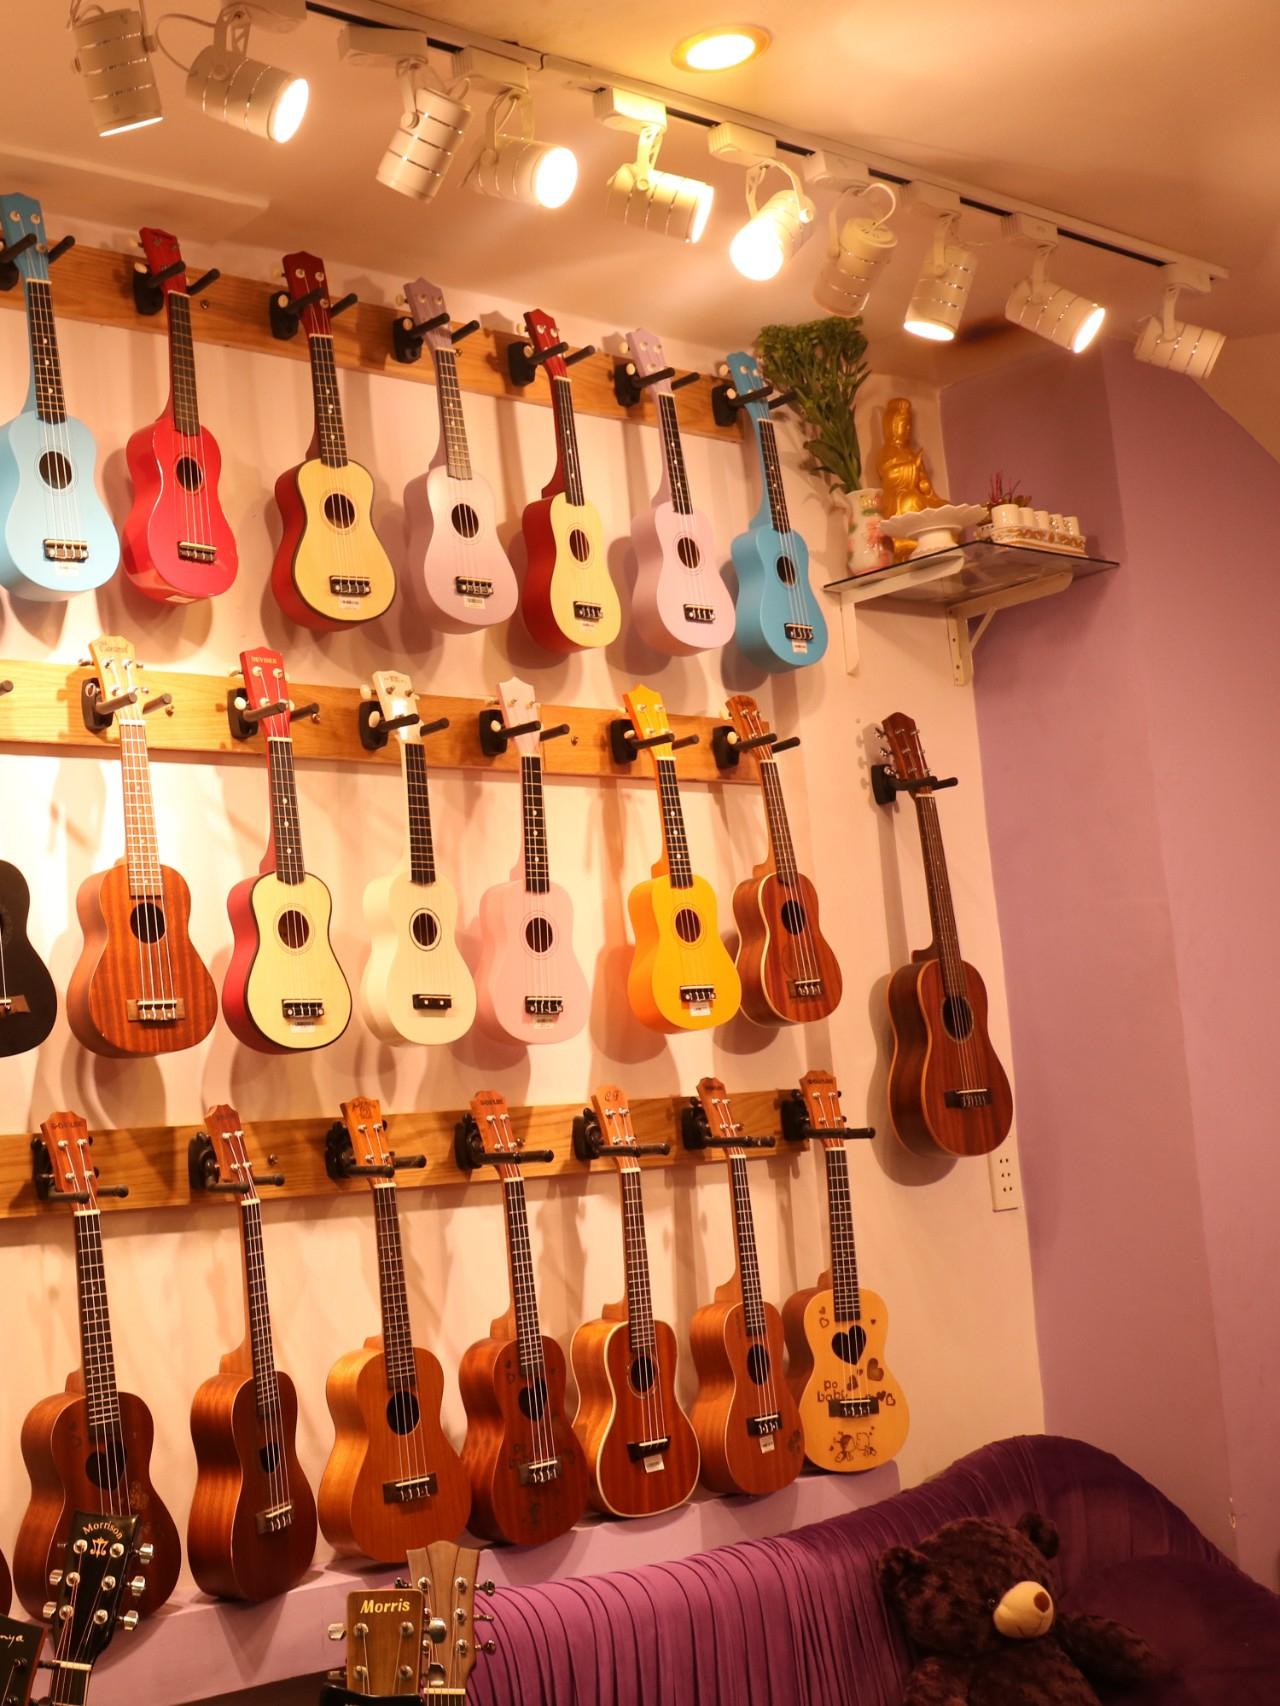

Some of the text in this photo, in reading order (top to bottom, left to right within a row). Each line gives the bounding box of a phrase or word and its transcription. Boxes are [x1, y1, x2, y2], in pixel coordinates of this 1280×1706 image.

[824, 1380, 838, 1391] po
[82, 1521, 123, 1540] Morrison
[360, 1598, 410, 1613] Morris
